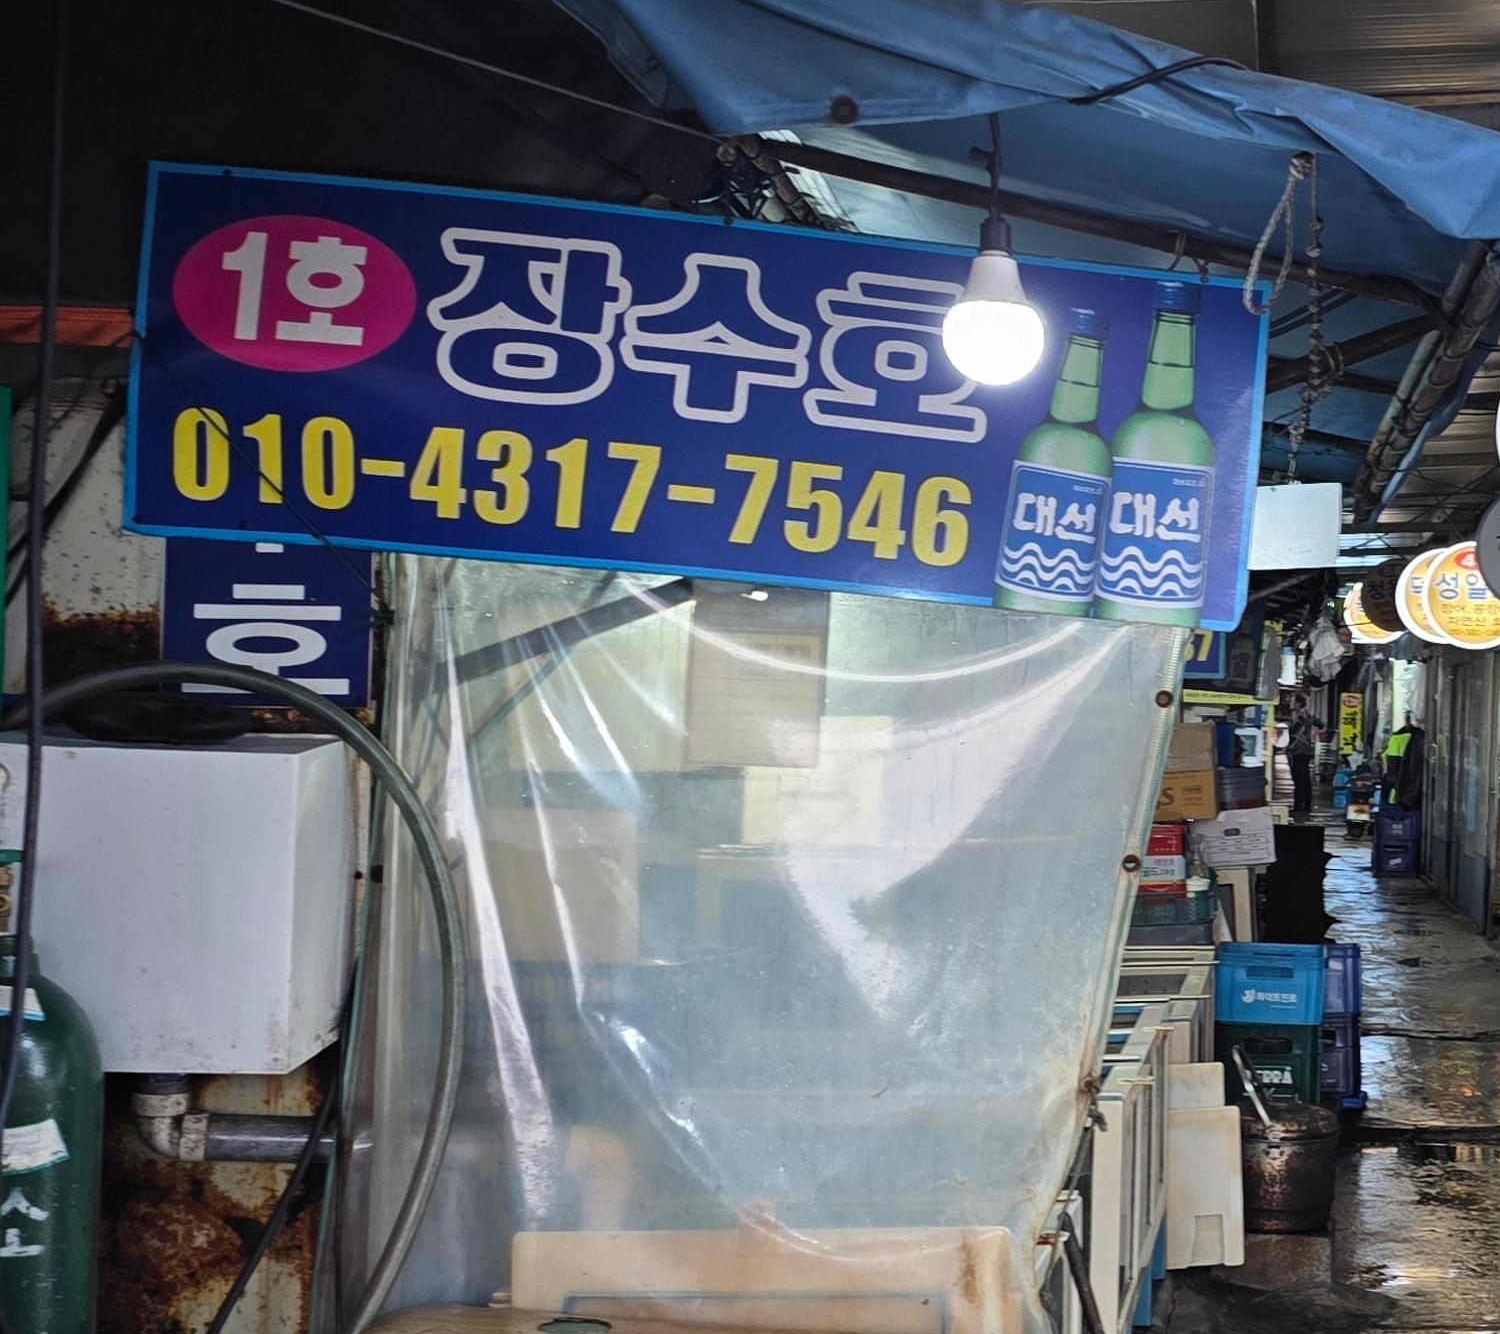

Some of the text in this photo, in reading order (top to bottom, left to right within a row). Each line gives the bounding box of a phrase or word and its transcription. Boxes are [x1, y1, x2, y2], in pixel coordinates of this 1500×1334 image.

[221, 231, 365, 347] 1호
[425, 227, 989, 444] 장수호
[172, 406, 972, 568] 010-4317-7546
[1012, 492, 1097, 544] 대선
[1109, 491, 1201, 543] 대선
